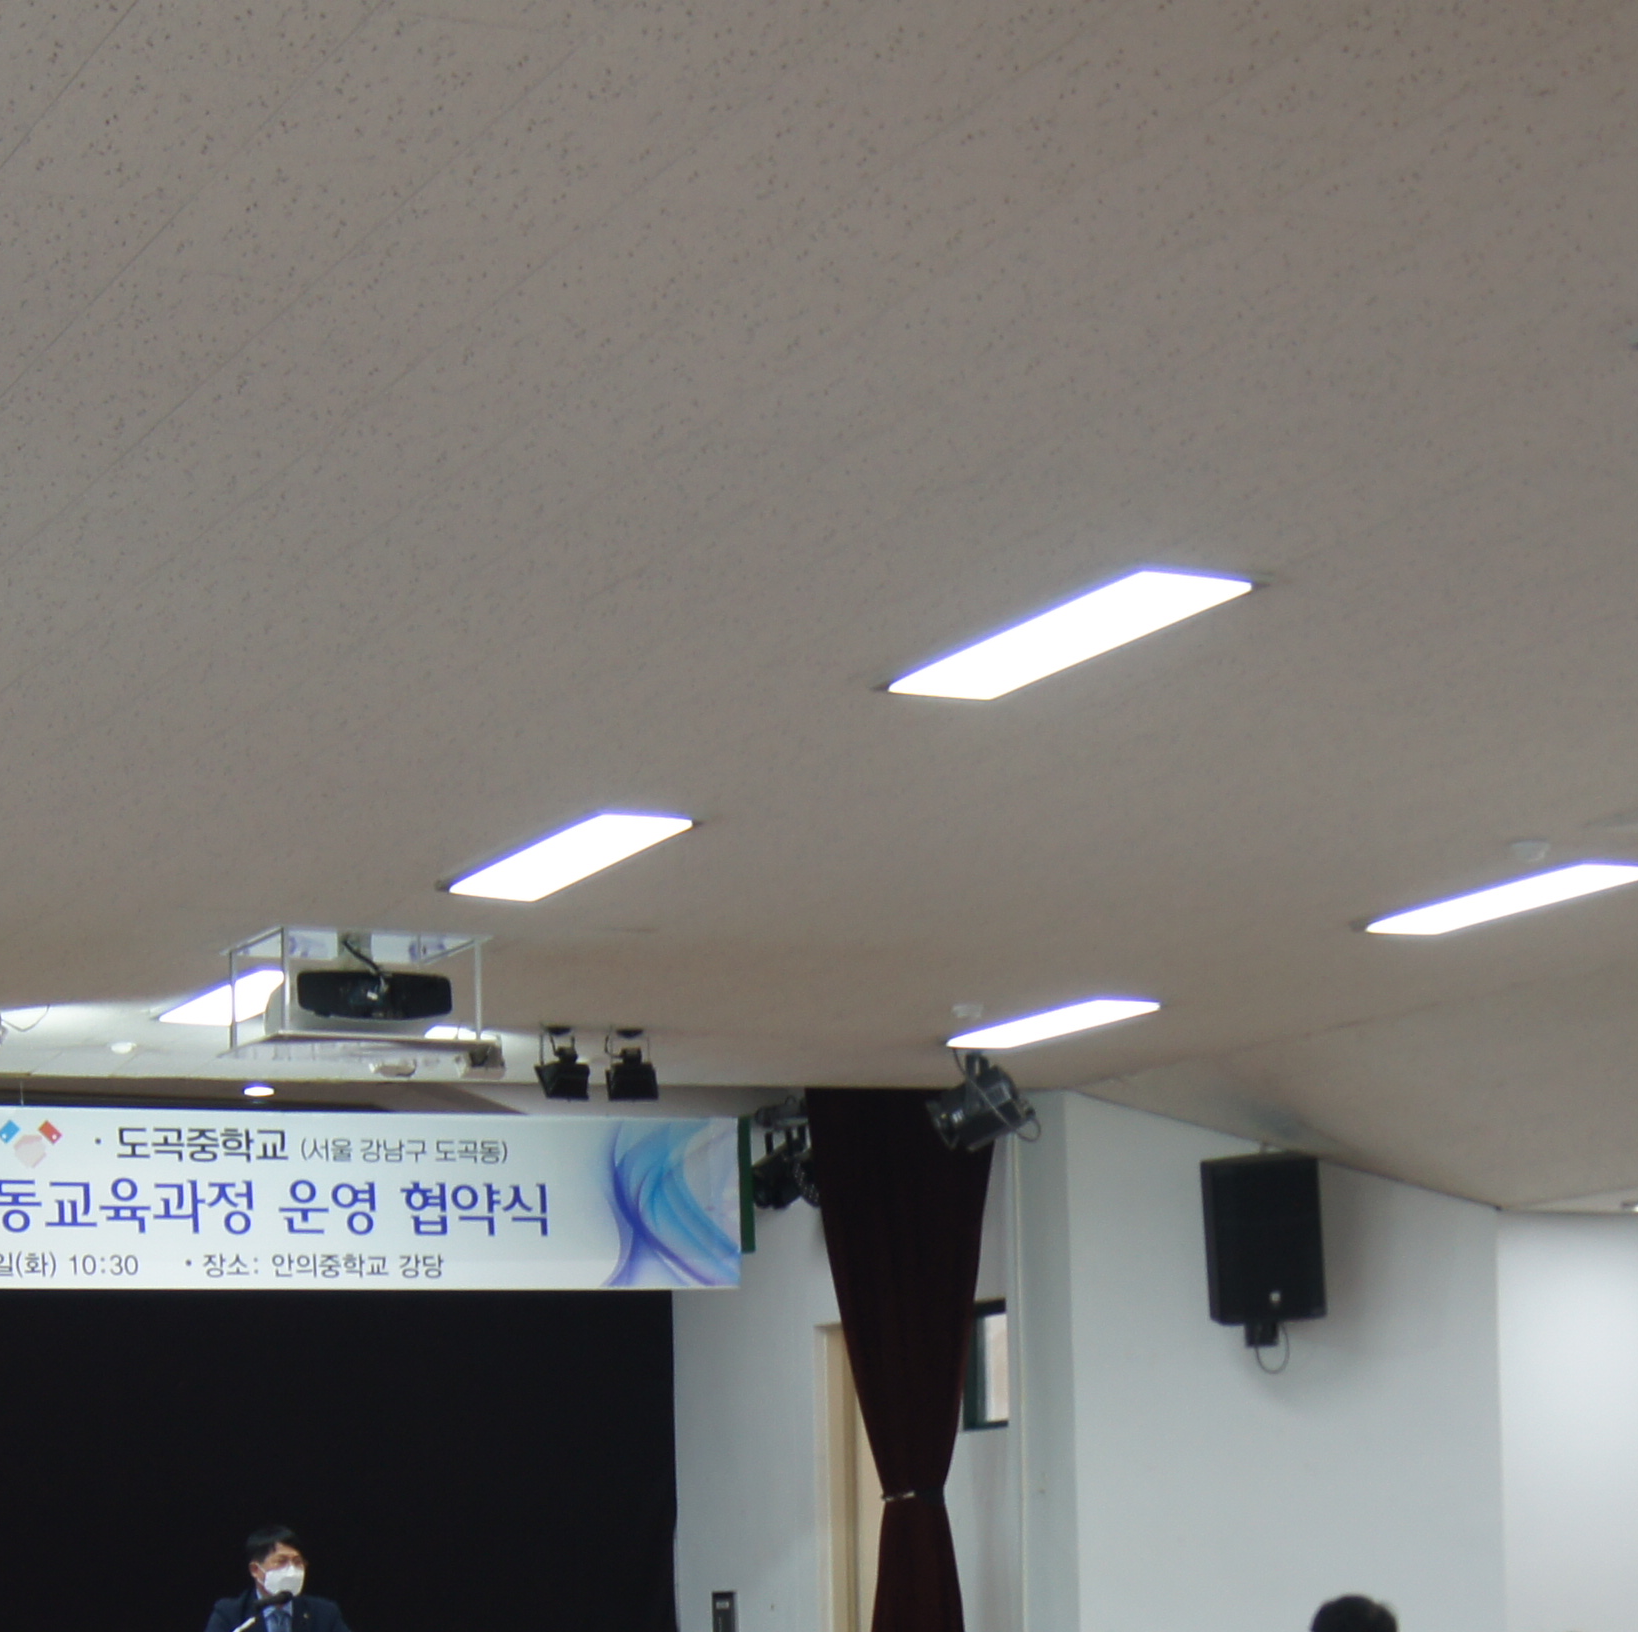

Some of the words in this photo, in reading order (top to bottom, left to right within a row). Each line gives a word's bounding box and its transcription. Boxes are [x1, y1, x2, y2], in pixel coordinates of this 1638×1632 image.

[116, 1126, 289, 1163] 도곡중학교
[300, 1137, 353, 1163] (서울
[360, 1138, 428, 1164] 강남구
[435, 1139, 509, 1165] 도곡동)
[278, 1179, 377, 1236] 운영
[400, 1180, 550, 1238] 협약식
[68, 1253, 139, 1277] 10:30
[202, 1253, 260, 1279] 장소:
[271, 1253, 390, 1279] 안의중학교
[398, 1254, 445, 1279] 강당
